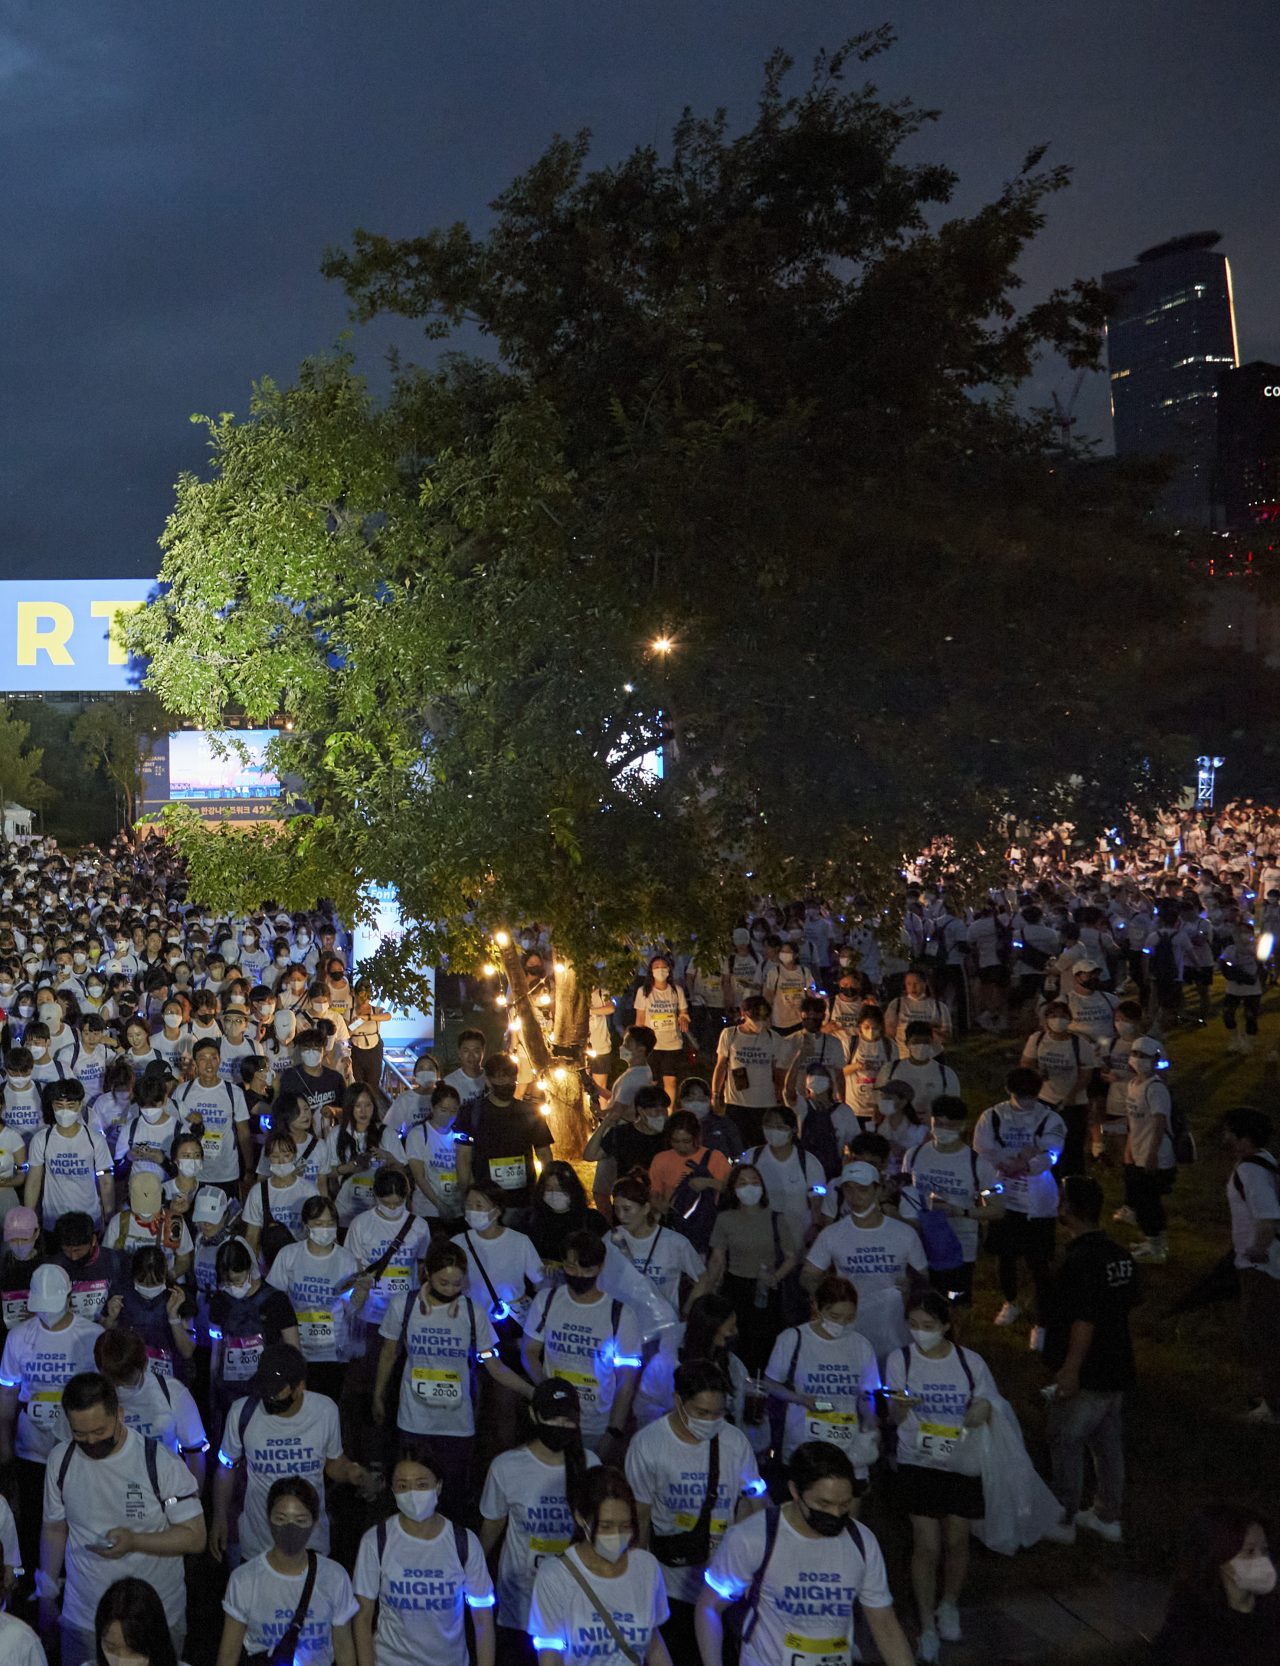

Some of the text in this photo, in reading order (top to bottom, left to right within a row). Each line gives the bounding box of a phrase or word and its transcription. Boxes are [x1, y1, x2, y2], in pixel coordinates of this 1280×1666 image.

[847, 1255, 896, 1265] NIGHT
[387, 1283, 410, 1292] 20:00
[309, 1328, 332, 1337] 20:00
[410, 1335, 463, 1347] NIGHT
[551, 1331, 602, 1348] NIGHT
[36, 1353, 67, 1361] 2022
[25, 1361, 77, 1374] NIGHT
[807, 1373, 860, 1383] NIGHT
[417, 1382, 426, 1396] C
[432, 1387, 458, 1398] 20:00
[33, 1404, 42, 1418] C
[827, 1430, 853, 1441] 20:00
[266, 1437, 302, 1447] 2022
[254, 1448, 314, 1461] NIGHT
[250, 1459, 321, 1475] WALKER
[403, 1568, 445, 1578] 2022
[798, 1572, 841, 1583] 2022
[389, 1581, 458, 1596] NIGHT
[784, 1585, 857, 1601] NIGHT
